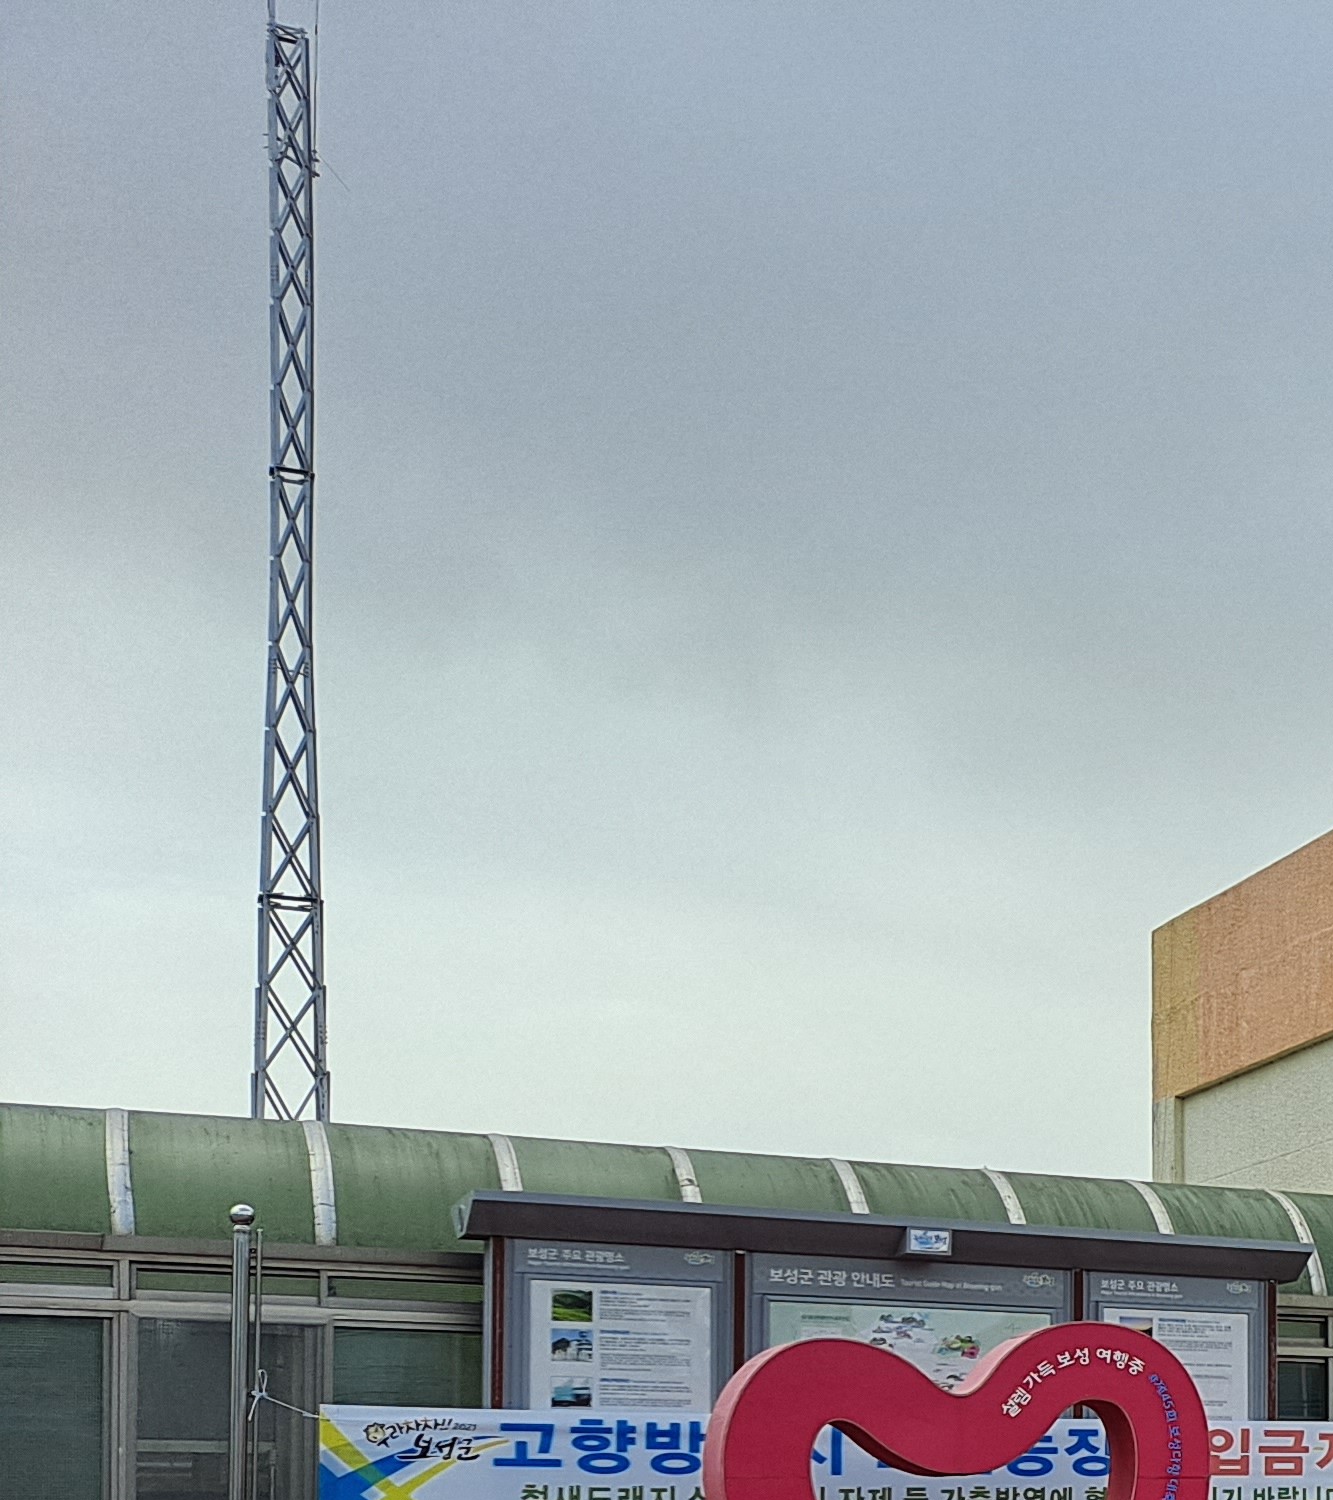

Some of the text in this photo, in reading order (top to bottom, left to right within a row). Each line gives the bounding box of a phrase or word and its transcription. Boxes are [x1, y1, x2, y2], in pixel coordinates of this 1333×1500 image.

[769, 1268, 896, 1288] 보성군 관광 안내도
[1001, 1387, 1032, 1418] 설렘
[1023, 1360, 1056, 1389] 가득
[1056, 1347, 1090, 1370] 보성
